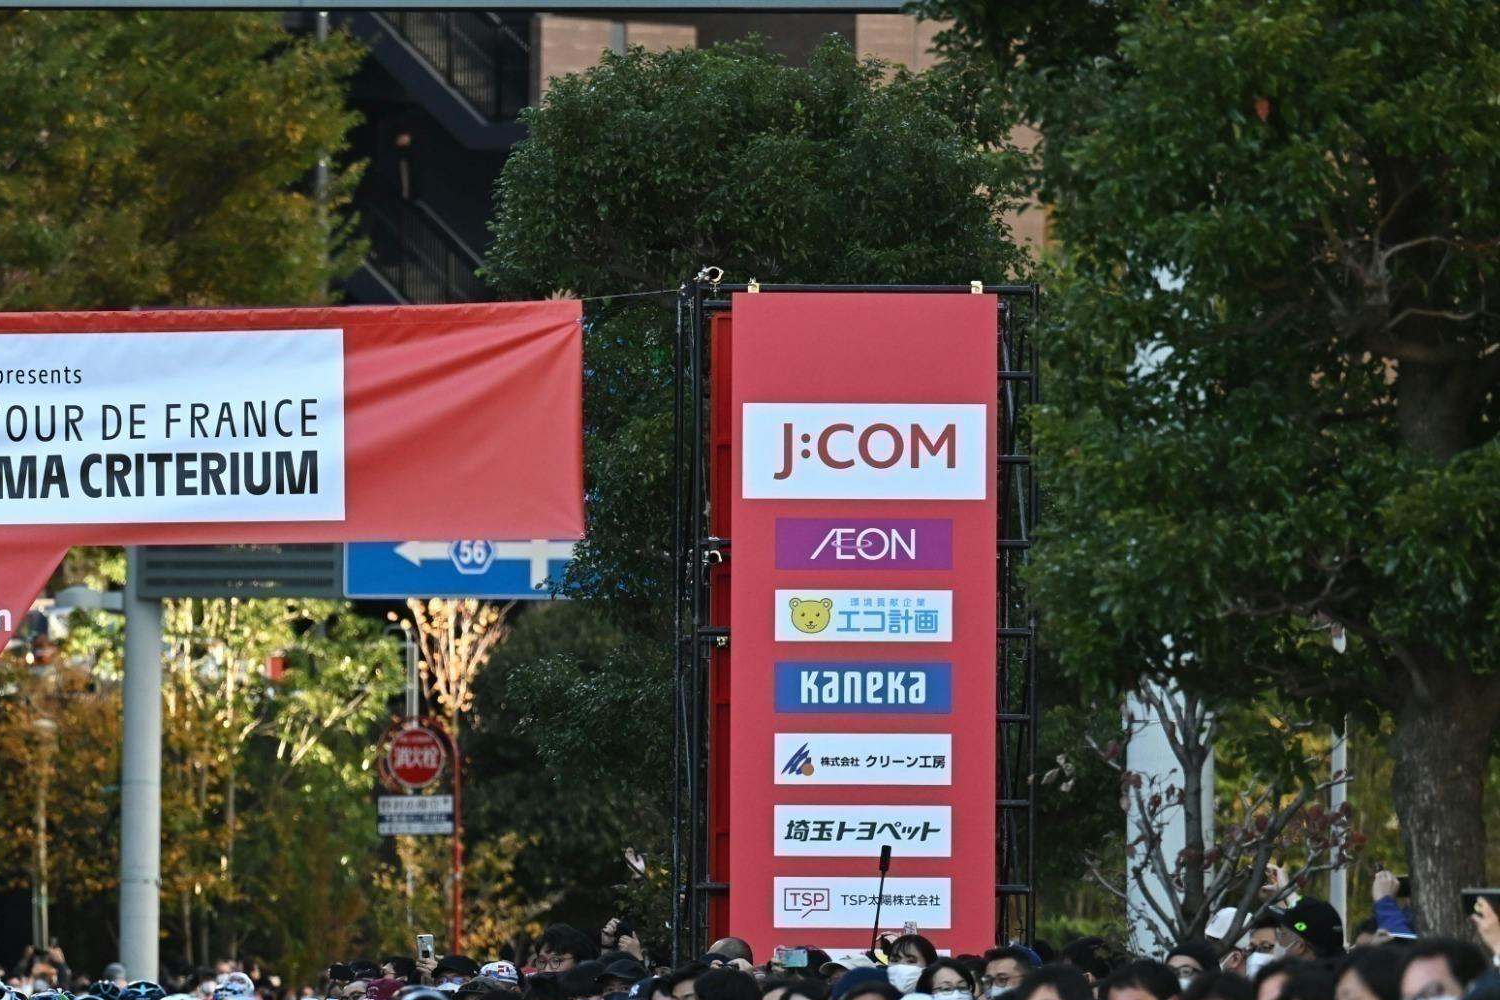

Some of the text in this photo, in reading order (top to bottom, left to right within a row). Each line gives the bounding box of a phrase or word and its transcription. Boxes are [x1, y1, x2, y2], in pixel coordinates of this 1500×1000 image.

[102, 403, 146, 440] DE
[165, 398, 319, 438] FRANCE
[773, 423, 956, 480] J:COM
[80, 450, 319, 498] CRITERIUM
[459, 540, 485, 565] 56
[837, 609, 938, 634] エコ計画
[821, 755, 946, 769] 株式会社 クリーン工房
[784, 820, 940, 841] 埼玉トヨペット
[790, 892, 825, 906] TSP
